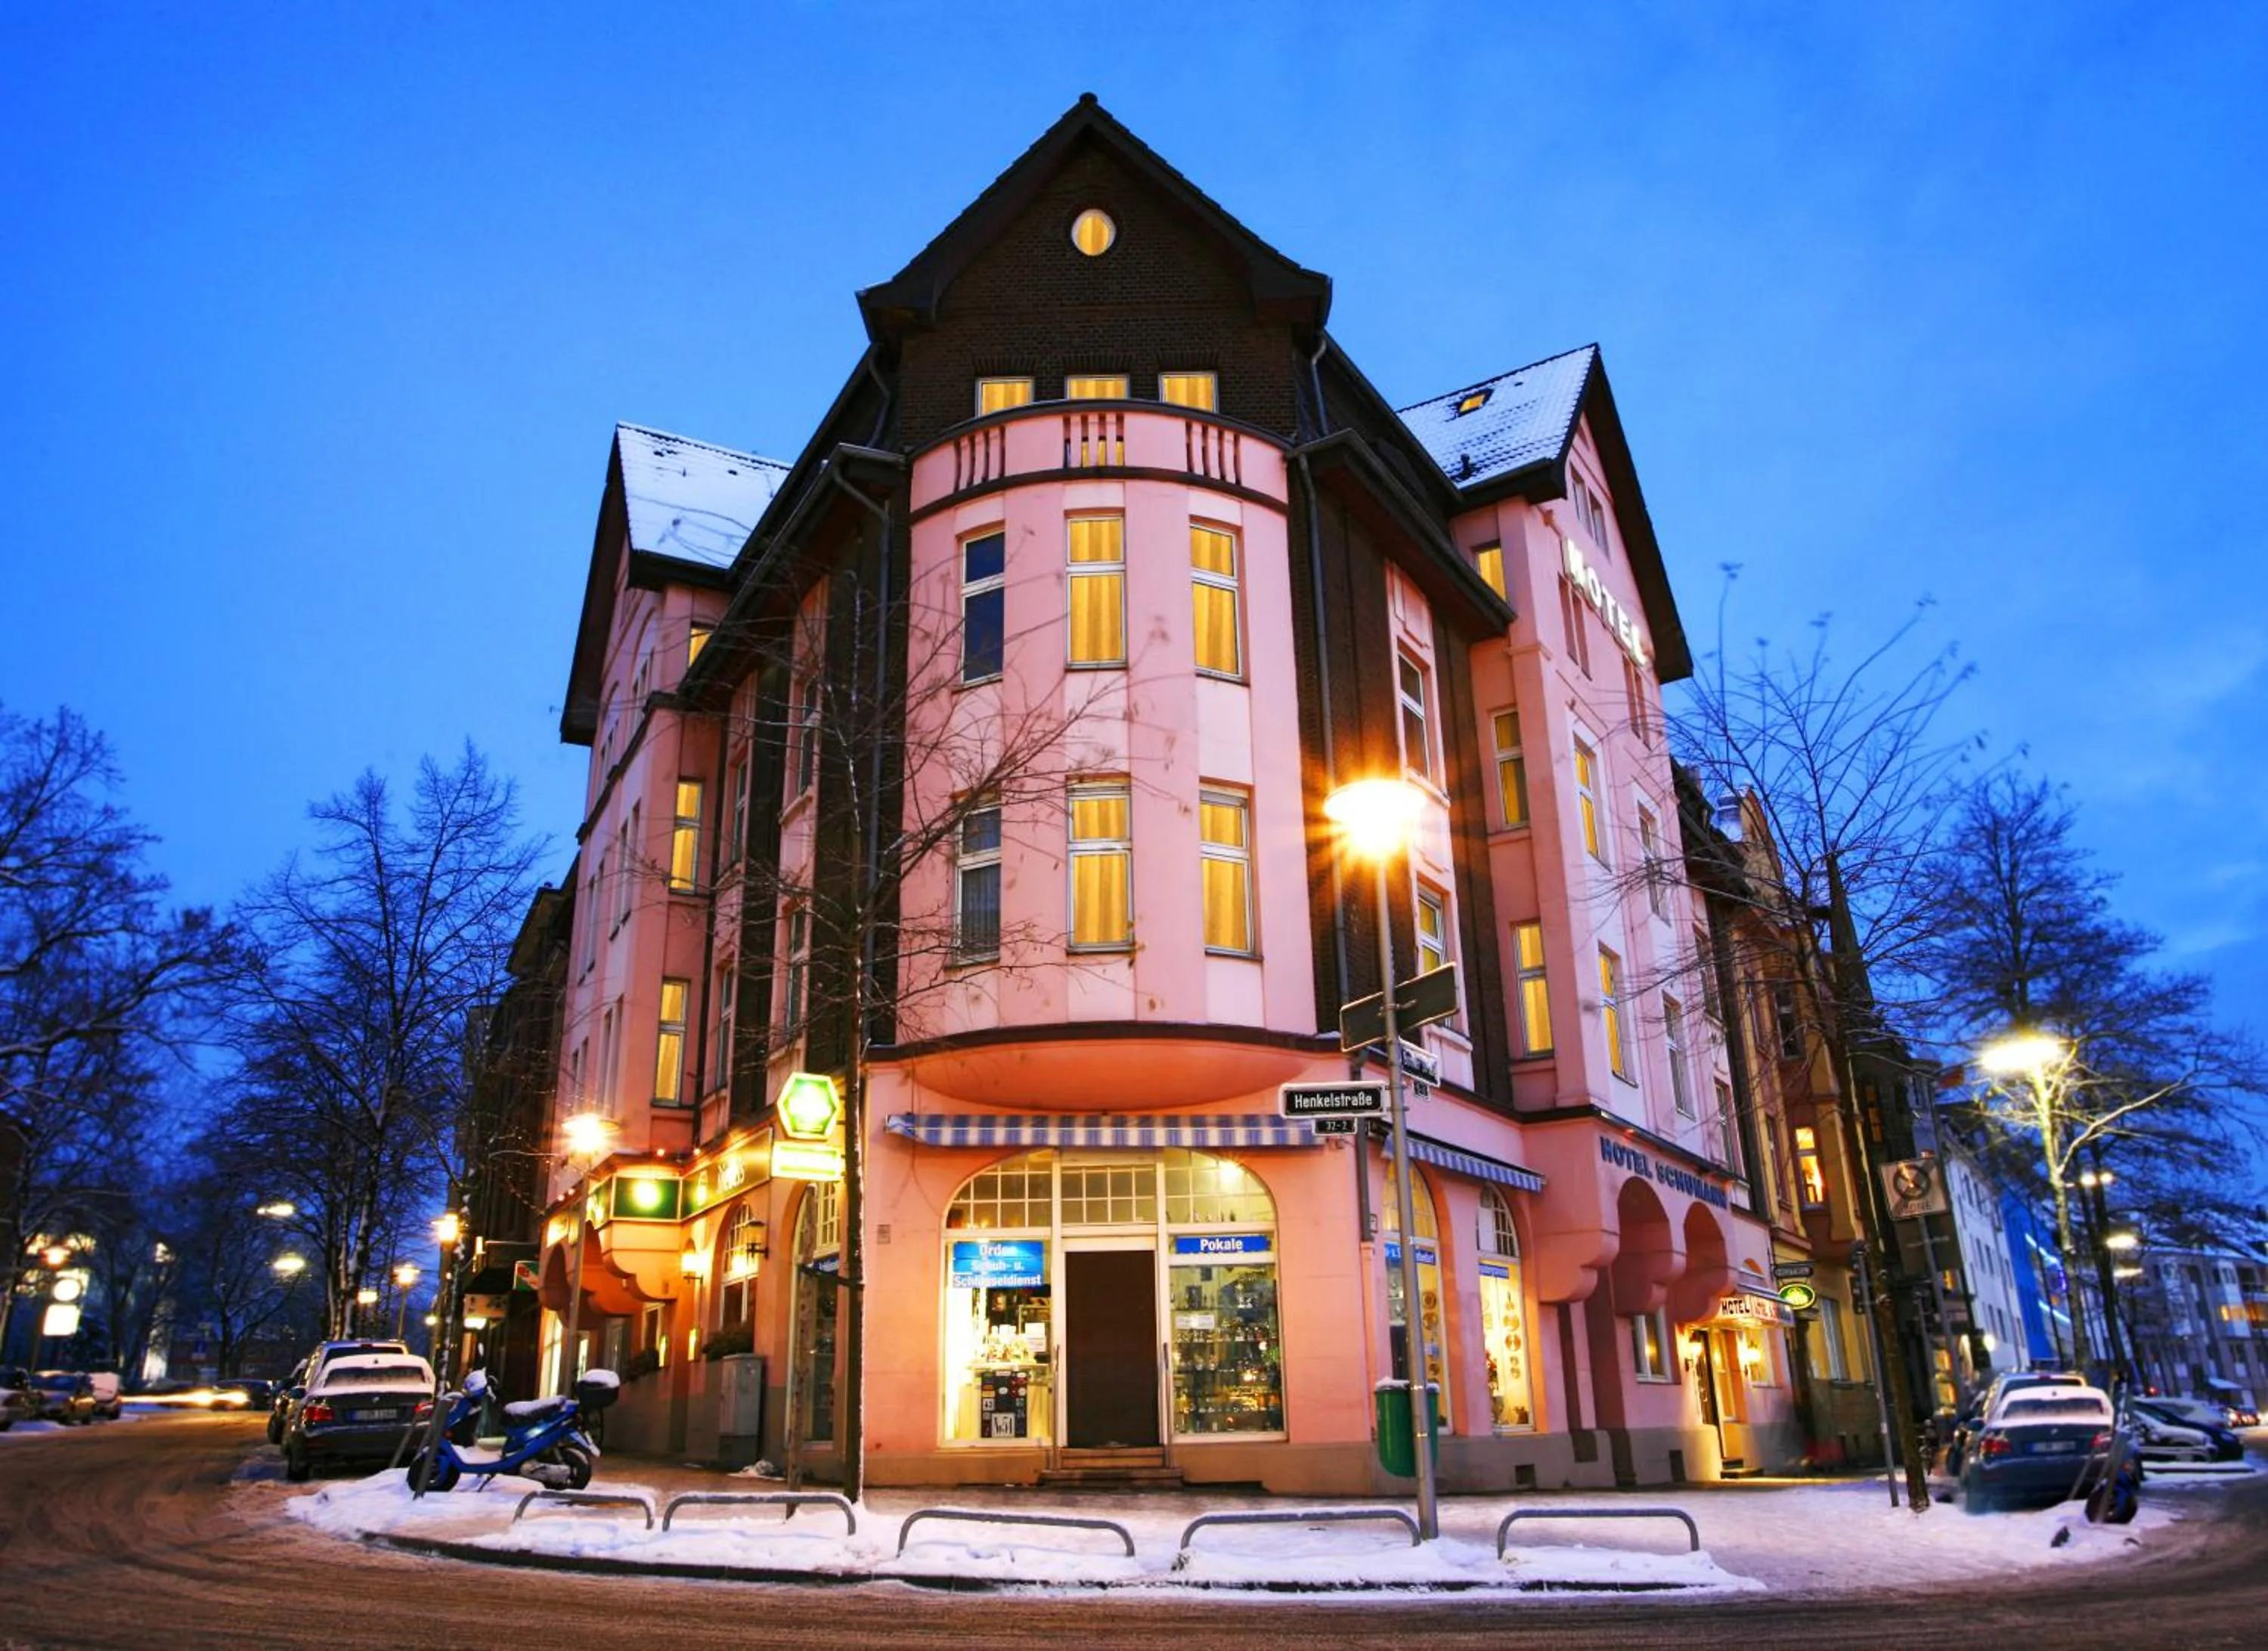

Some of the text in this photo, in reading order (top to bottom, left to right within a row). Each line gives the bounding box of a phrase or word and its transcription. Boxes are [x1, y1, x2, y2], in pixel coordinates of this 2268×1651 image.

[1565, 537, 1648, 666] HOTEL
[1294, 1091, 1373, 1109] Henkelstraße
[1599, 1135, 1653, 1180] HOTEL
[1200, 1237, 1244, 1251] Pokale
[1721, 1299, 1750, 1315] HOTEL
